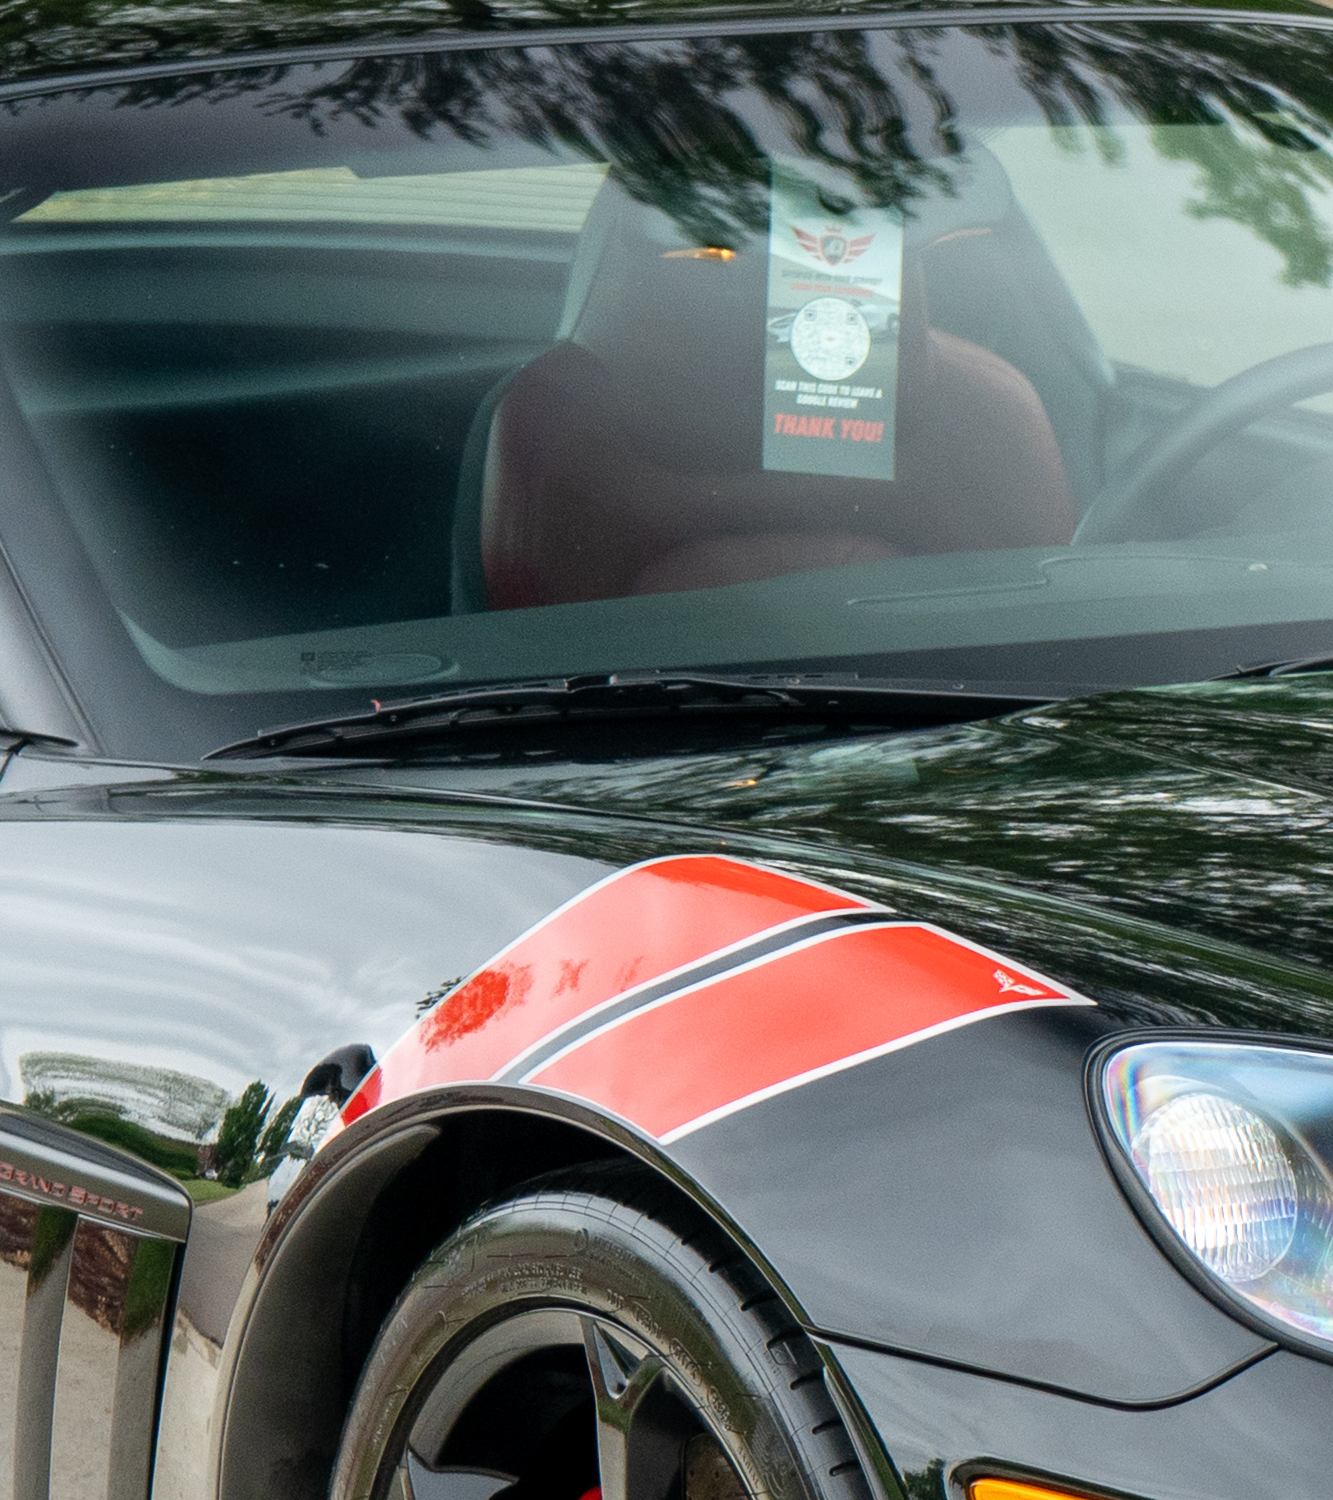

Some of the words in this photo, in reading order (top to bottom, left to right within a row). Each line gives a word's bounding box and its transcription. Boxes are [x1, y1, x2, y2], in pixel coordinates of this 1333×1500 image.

[774, 412, 836, 439] THANK
[841, 419, 884, 443] YOU!
[0, 1161, 66, 1197] GRAND
[68, 1185, 144, 1220] SPORT
